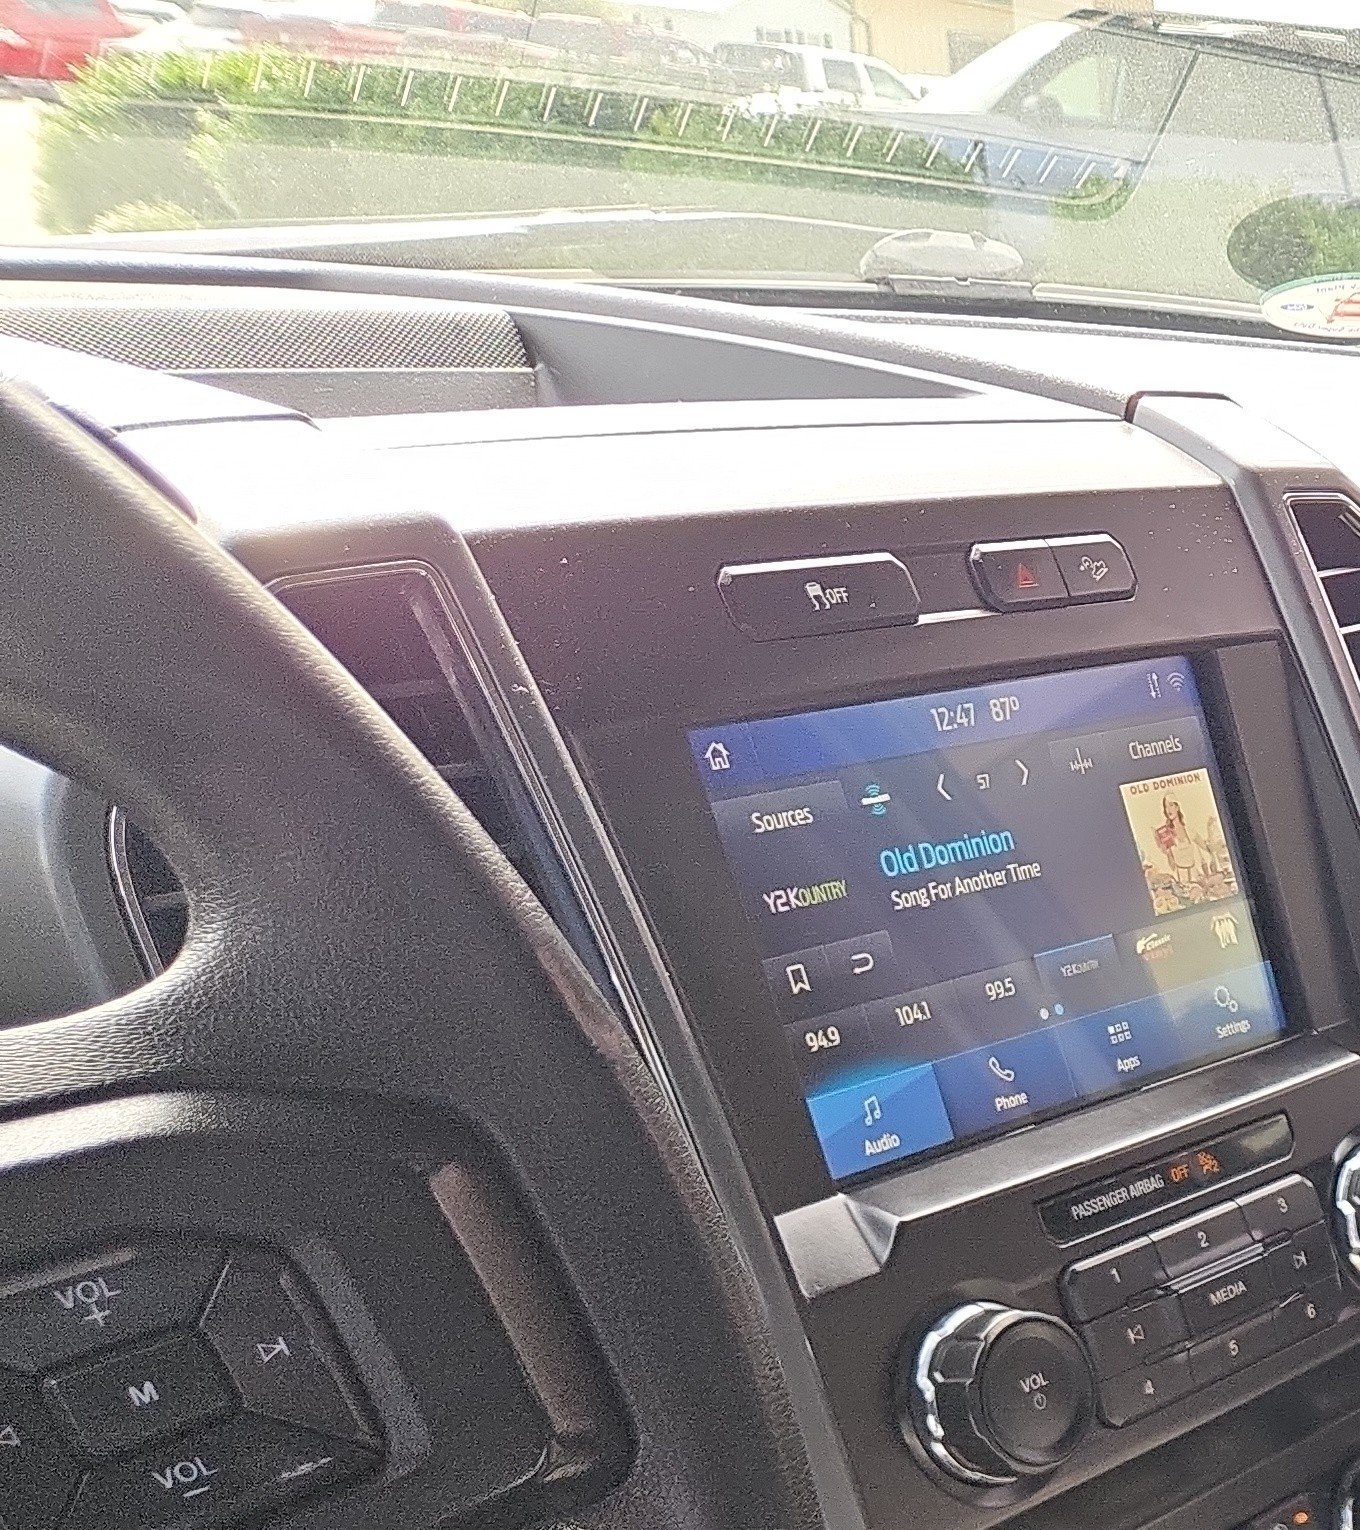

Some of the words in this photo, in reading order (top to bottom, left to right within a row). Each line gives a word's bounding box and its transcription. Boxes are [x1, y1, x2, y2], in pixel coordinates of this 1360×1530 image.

[825, 586, 849, 605] OFF
[930, 702, 975, 732] 12:47
[1128, 734, 1183, 761] Channels
[1130, 781, 1150, 796] OLD
[1152, 771, 1202, 791] DOMINION
[751, 806, 814, 834] Sources
[879, 843, 921, 877] Old
[918, 829, 1016, 870] Dominion
[890, 886, 932, 911] Song
[928, 880, 954, 902] For
[954, 868, 1008, 897] Another
[1006, 861, 1042, 883] Time
[985, 976, 1016, 1001] 99.5
[1215, 1018, 1252, 1040] Settings
[1116, 1054, 1142, 1073] Apps
[994, 1091, 1029, 1112] Phone
[864, 1131, 901, 1157] Audio
[1070, 1187, 1131, 1221] PASSENGER
[1128, 1173, 1166, 1200] AIRBAG
[1170, 1164, 1190, 1183] OFF
[1277, 1197, 1289, 1213] 3
[1197, 1231, 1209, 1248] 2
[1109, 1267, 1121, 1284] 1
[54, 1276, 122, 1309] VOL
[1208, 1280, 1248, 1306] MEDIA
[1306, 1303, 1316, 1319] 6
[1228, 1339, 1239, 1356] 5
[128, 1381, 160, 1407] M
[1020, 1372, 1050, 1393] VOL
[1143, 1379, 1155, 1395] 4
[152, 1456, 220, 1489] VOL
